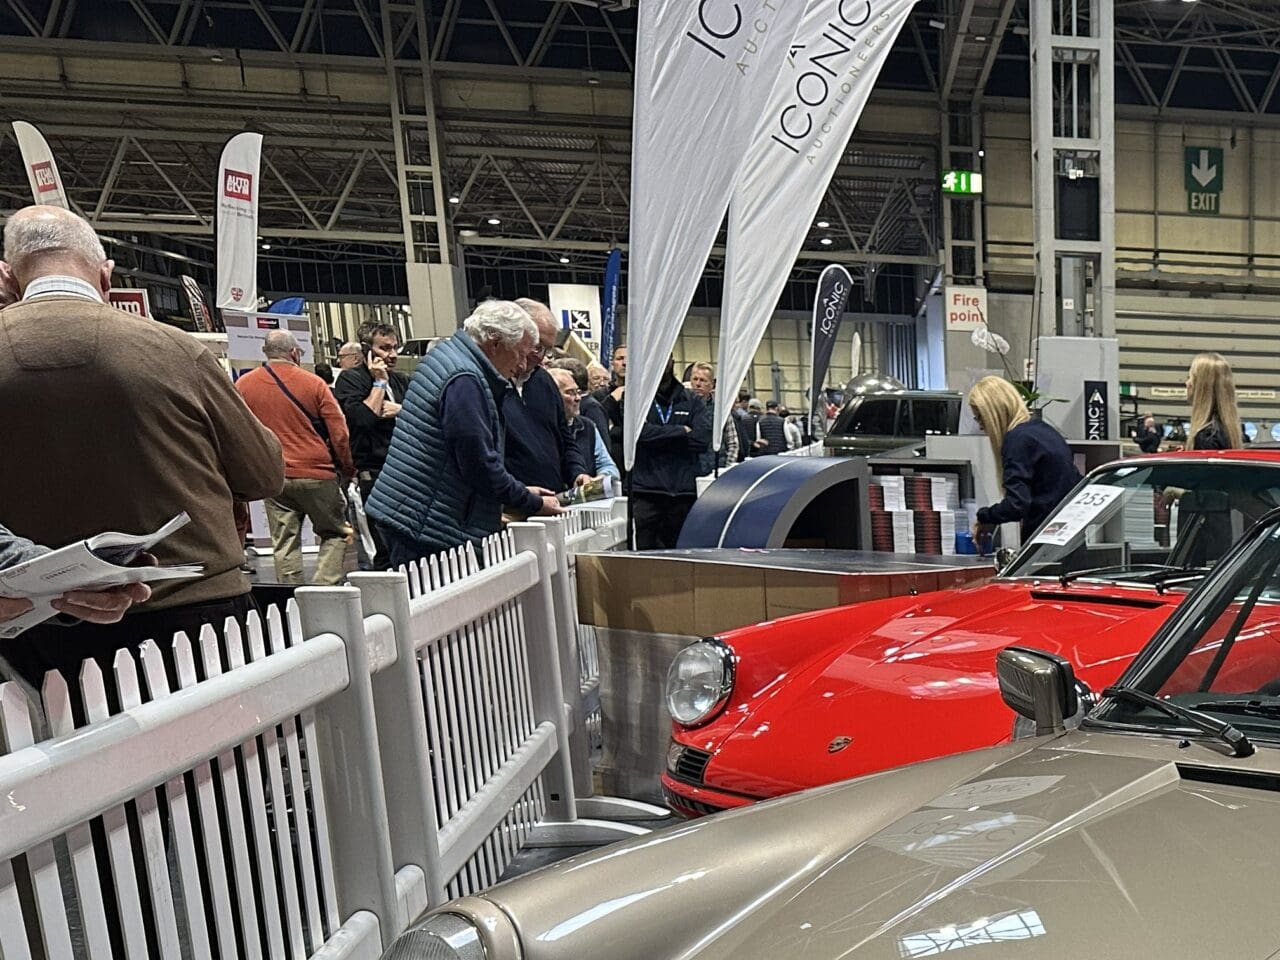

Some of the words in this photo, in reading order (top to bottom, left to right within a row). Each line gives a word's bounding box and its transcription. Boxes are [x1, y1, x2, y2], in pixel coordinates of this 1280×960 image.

[771, 0, 872, 154] ICONIC
[806, 11, 891, 165] AUCTIONEERS
[1191, 192, 1218, 211] EXIT
[820, 281, 844, 335] ICONIC
[953, 294, 980, 307] Fire
[1074, 492, 1111, 507] 255
